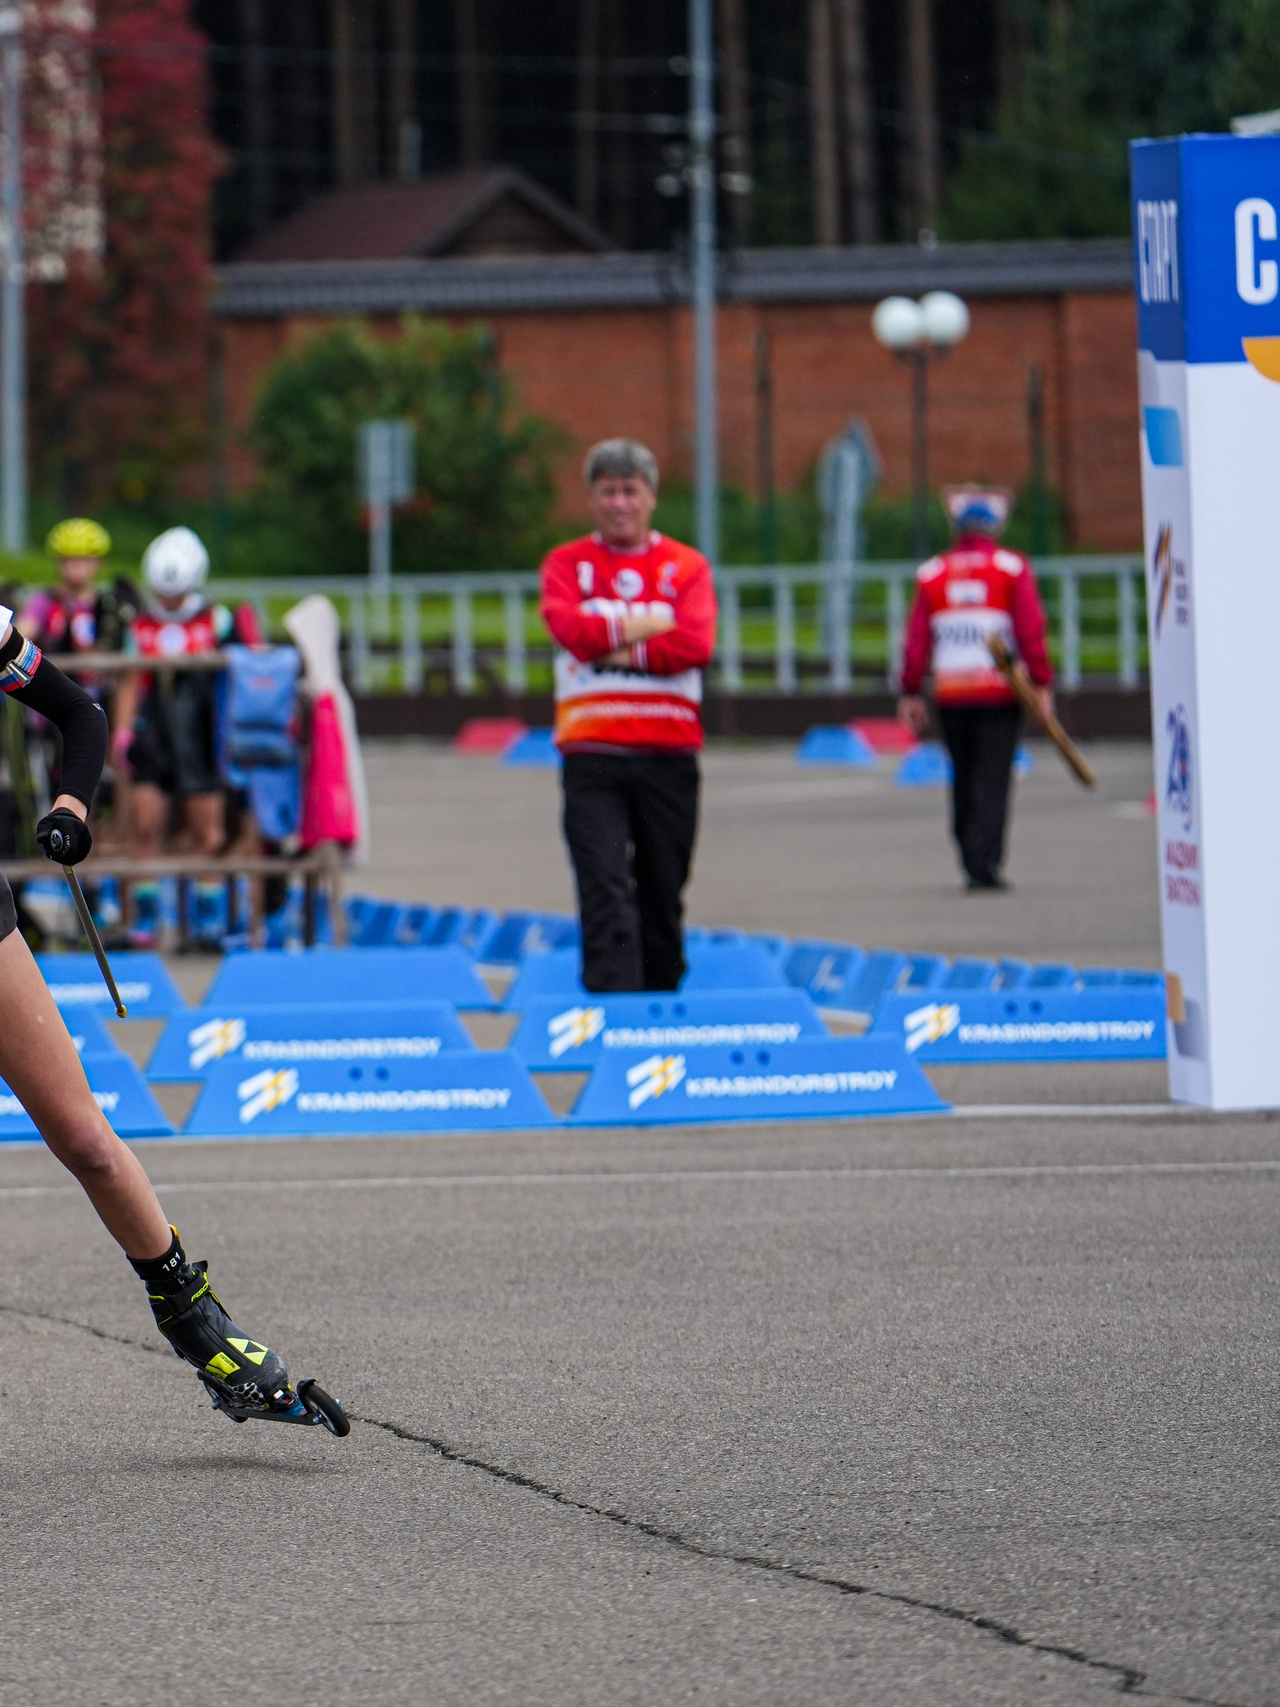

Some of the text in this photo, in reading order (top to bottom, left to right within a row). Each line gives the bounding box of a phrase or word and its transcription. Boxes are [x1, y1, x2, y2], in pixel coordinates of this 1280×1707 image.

[1138, 200, 1179, 303] СТАРТ
[603, 1022, 801, 1047] KRASINDORSTROY
[958, 1021, 1155, 1043] KRASINDORSTROY
[243, 1037, 441, 1060] KRASINDORSTROY
[686, 1070, 897, 1098] KRASINDORSTROY
[298, 1088, 511, 1112] KRASINDORSTROY
[163, 1252, 181, 1271] 181
